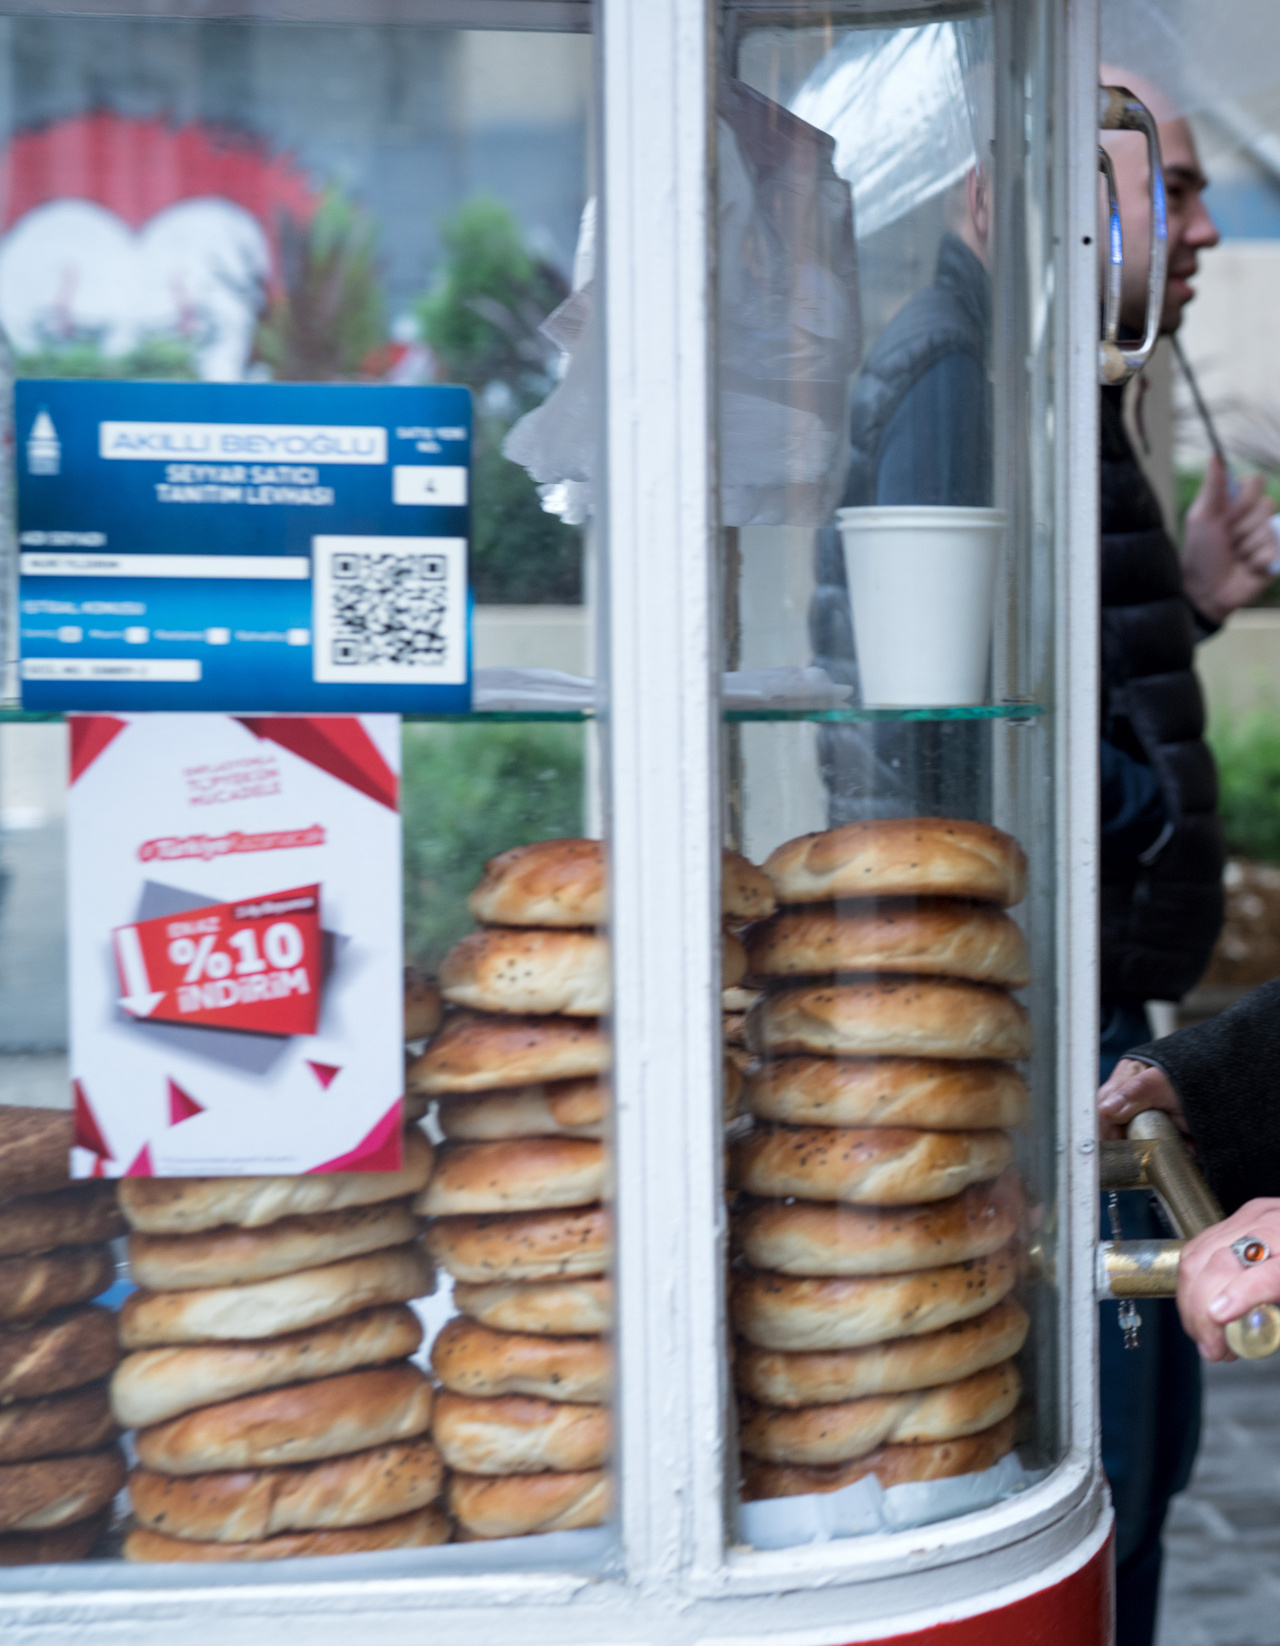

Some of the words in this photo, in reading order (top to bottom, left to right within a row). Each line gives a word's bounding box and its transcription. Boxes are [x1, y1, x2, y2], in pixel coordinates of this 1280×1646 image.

[113, 433, 209, 452] AKILLI
[220, 431, 376, 456] BEYOĞLU
[165, 463, 247, 485] SEYYAR
[249, 465, 318, 486] SATICI
[157, 484, 243, 504] TANITIM
[168, 922, 304, 982] %10
